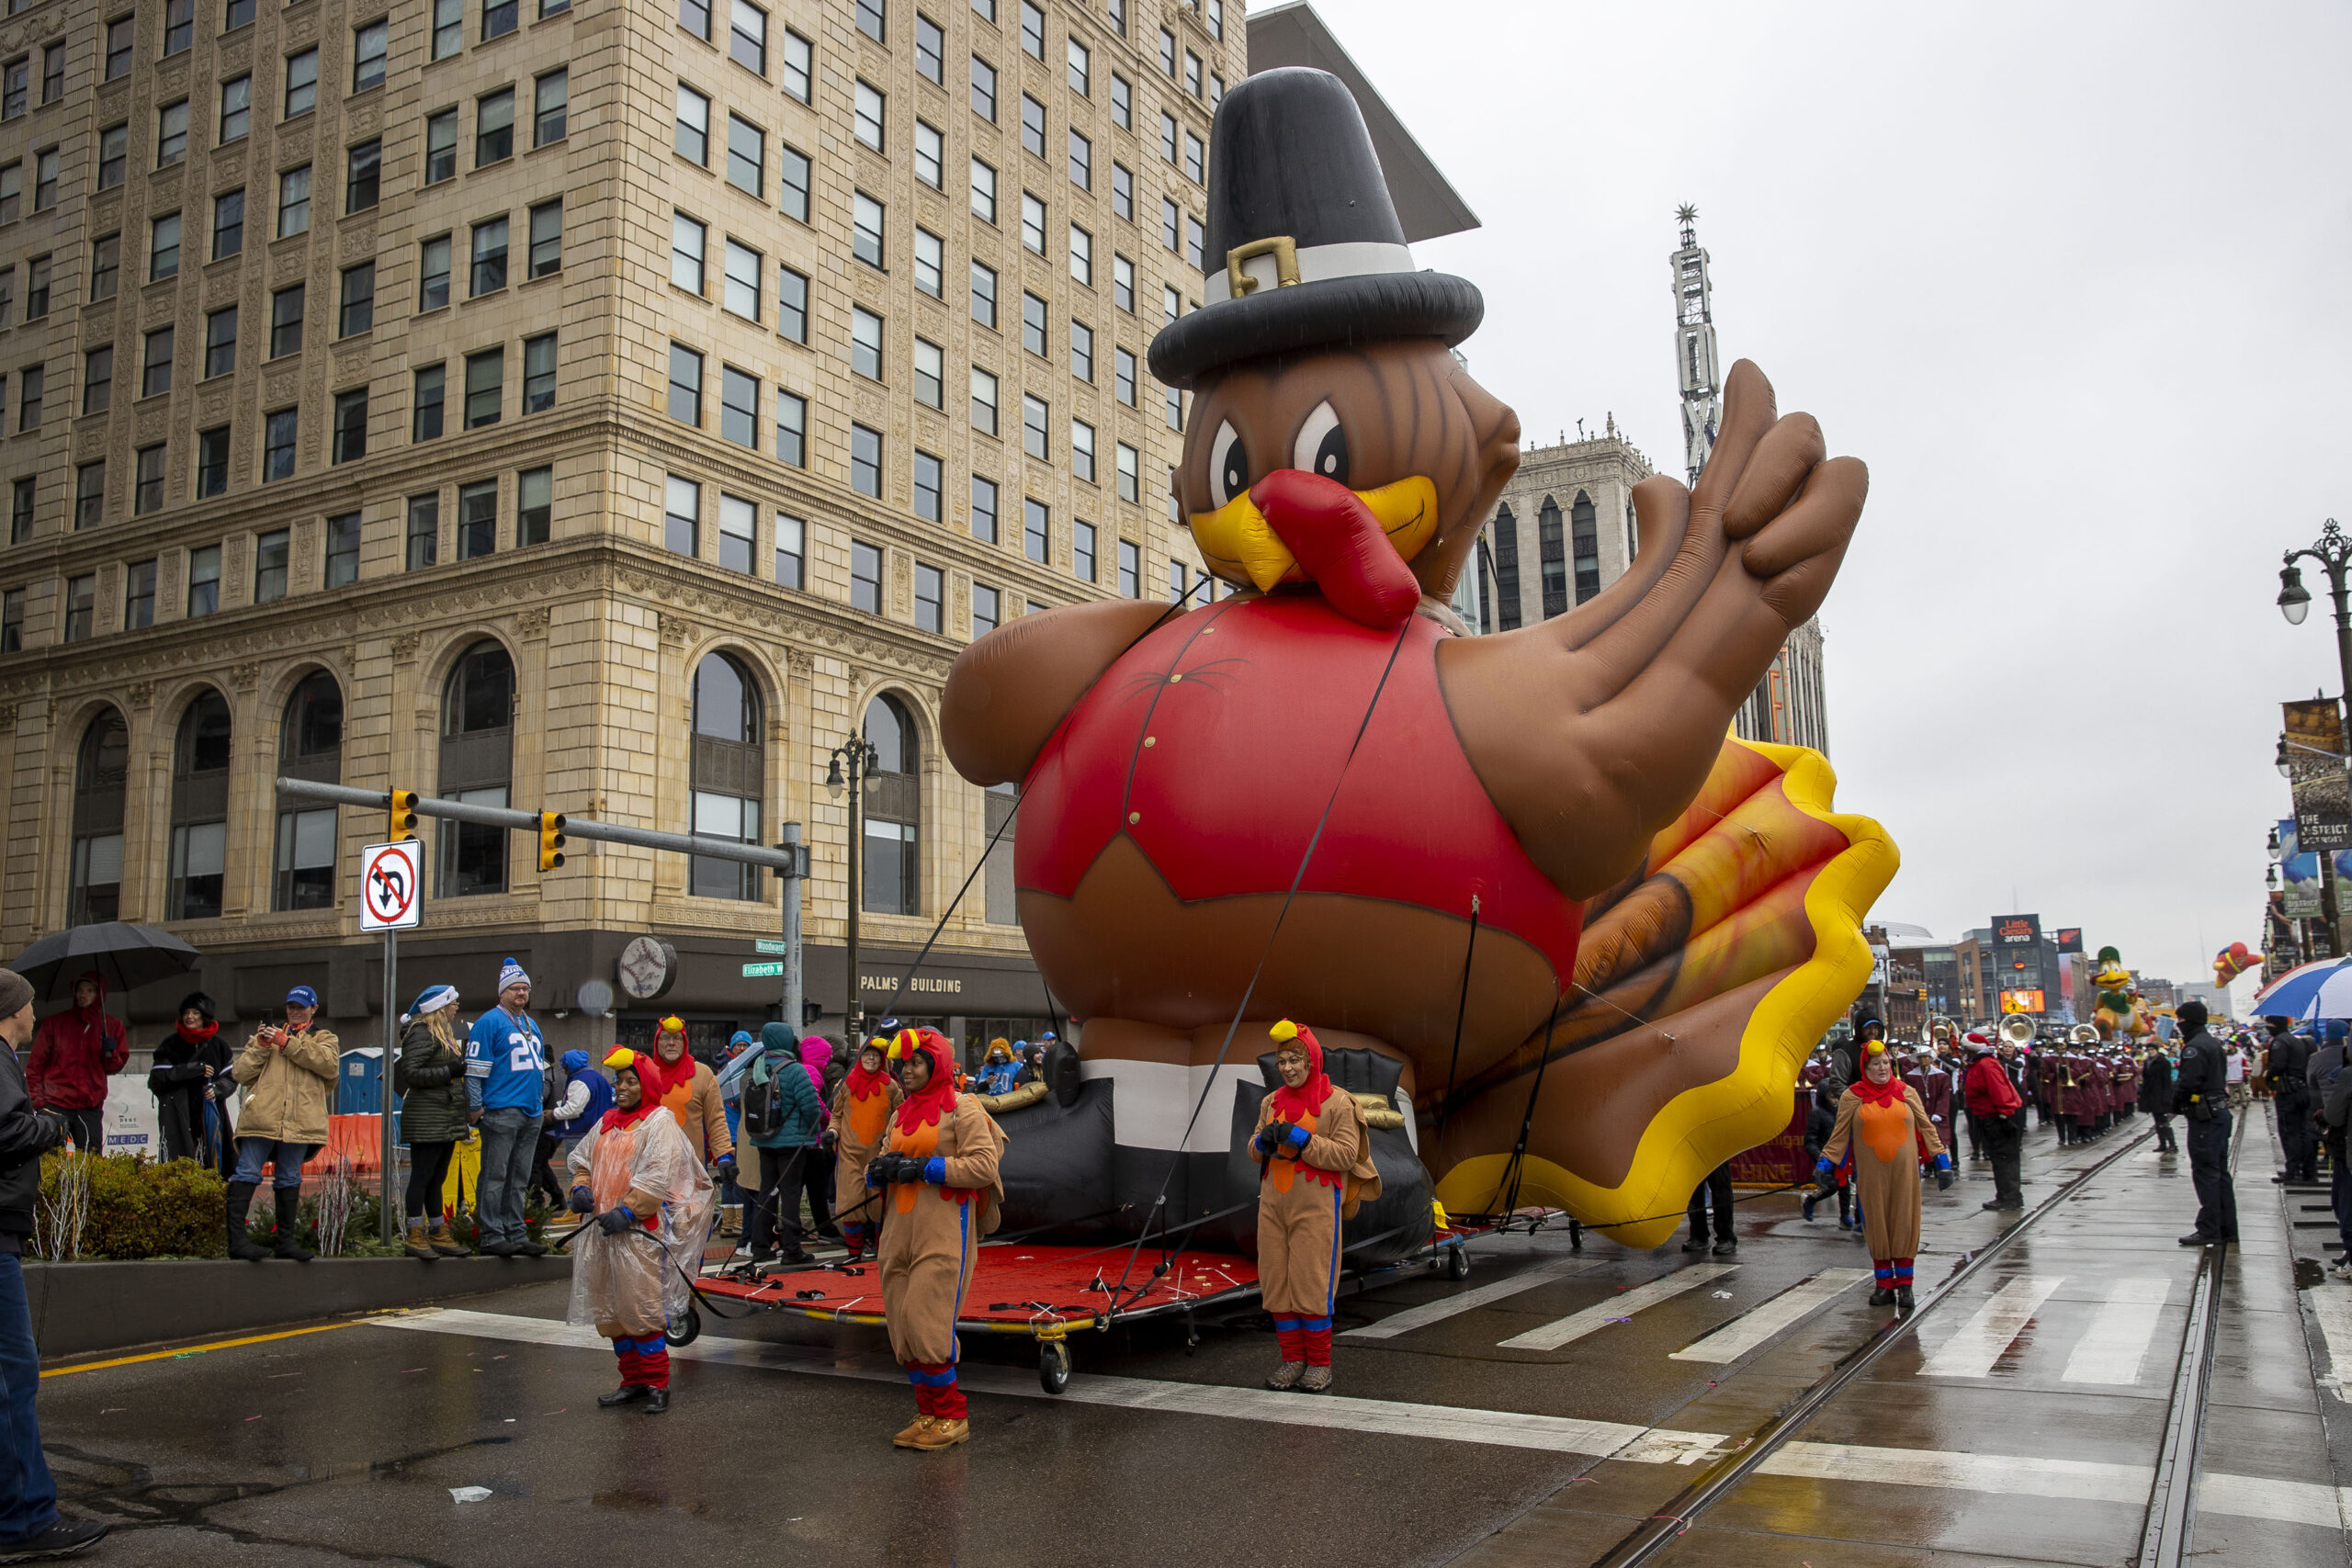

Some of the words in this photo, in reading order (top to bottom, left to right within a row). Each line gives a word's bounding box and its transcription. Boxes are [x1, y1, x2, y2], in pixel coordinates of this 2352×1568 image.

[2300, 814, 2320, 825] THE
[2006, 919, 2029, 929] Little
[1999, 927, 2033, 936] Caesars
[2004, 935, 2030, 943] arena
[758, 942, 785, 952] Woodward
[744, 964, 775, 975] Elizabeth
[860, 976, 899, 991] PALMS
[910, 977, 961, 993] BUILDING
[509, 1032, 544, 1072] 20
[108, 1134, 147, 1145] MEDC
